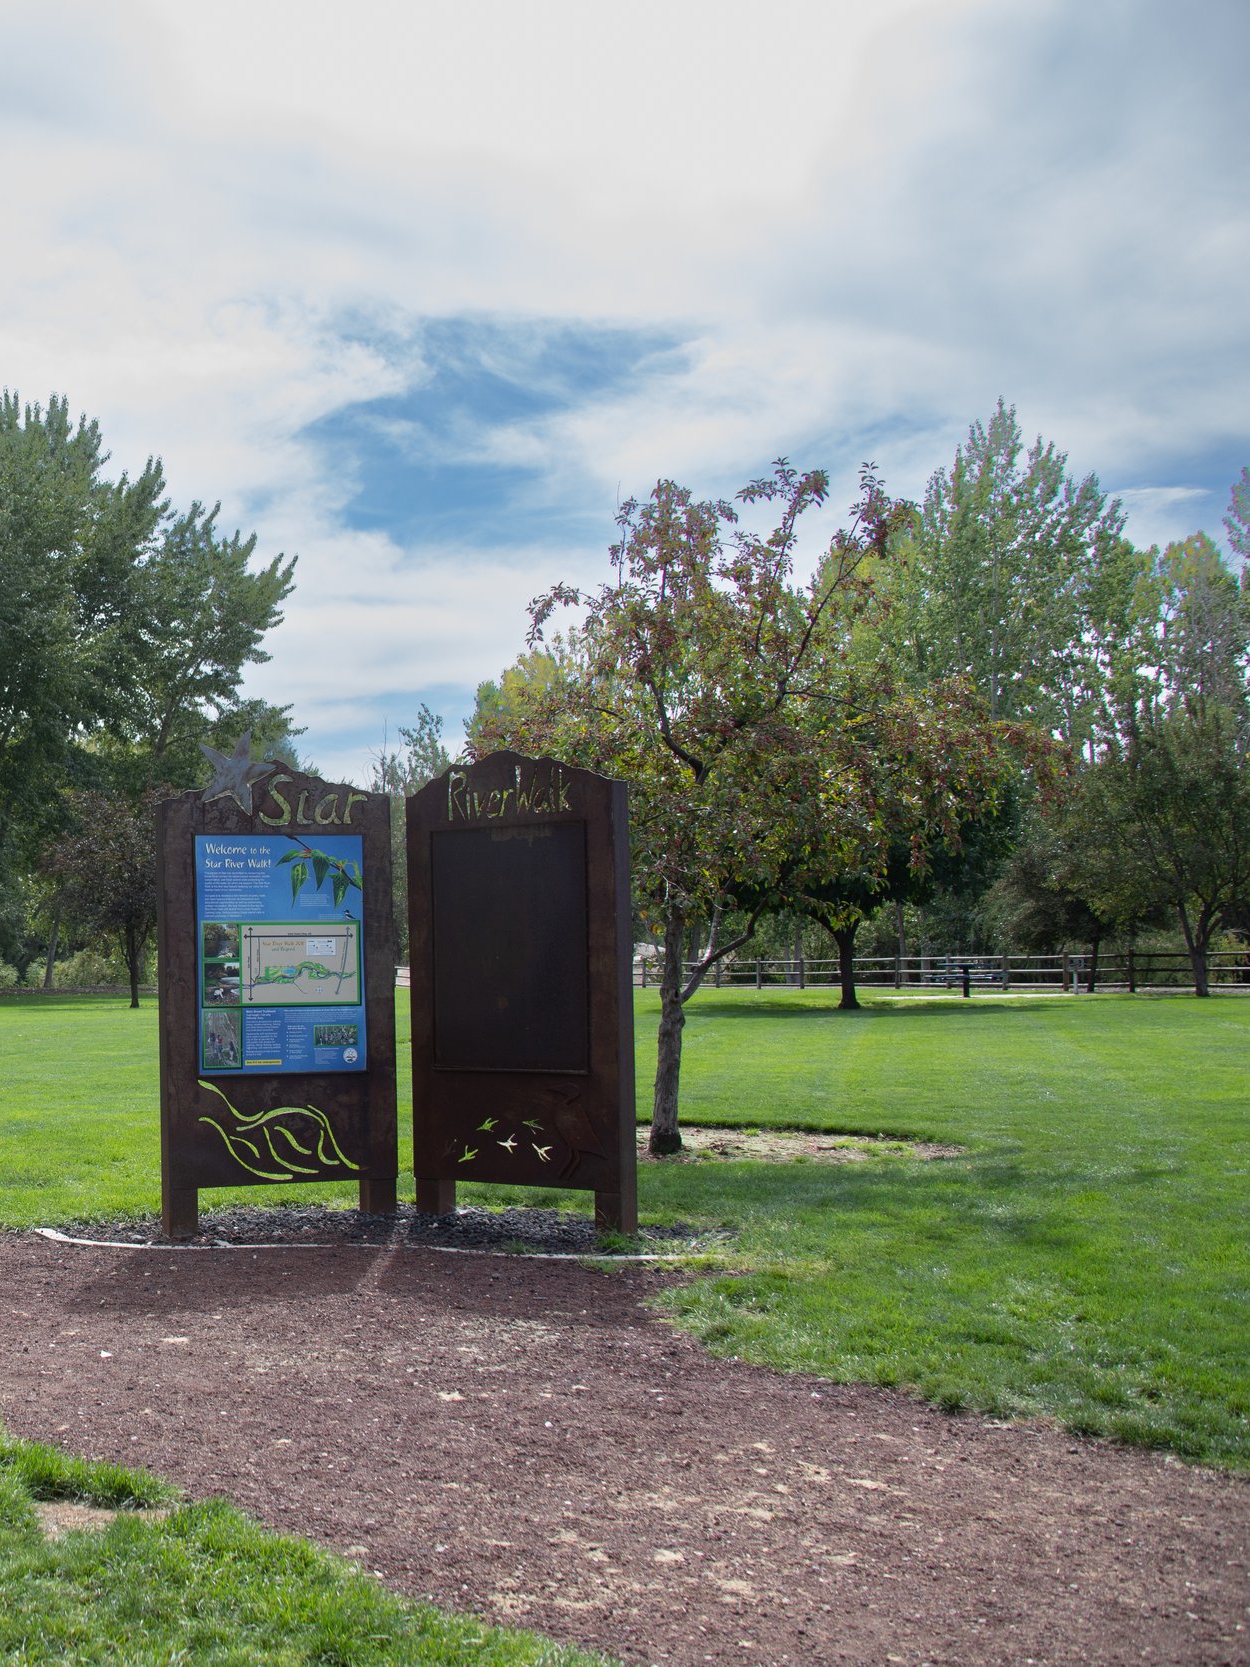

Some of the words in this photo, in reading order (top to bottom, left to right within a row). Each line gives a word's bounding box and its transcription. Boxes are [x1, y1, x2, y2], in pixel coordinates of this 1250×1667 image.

[259, 774, 368, 826] Star
[205, 843, 247, 855] Welcome
[250, 847, 258, 855] to
[259, 846, 271, 855] the
[205, 858, 222, 868] Star
[225, 858, 245, 868] River
[247, 858, 271, 868] Walk!
